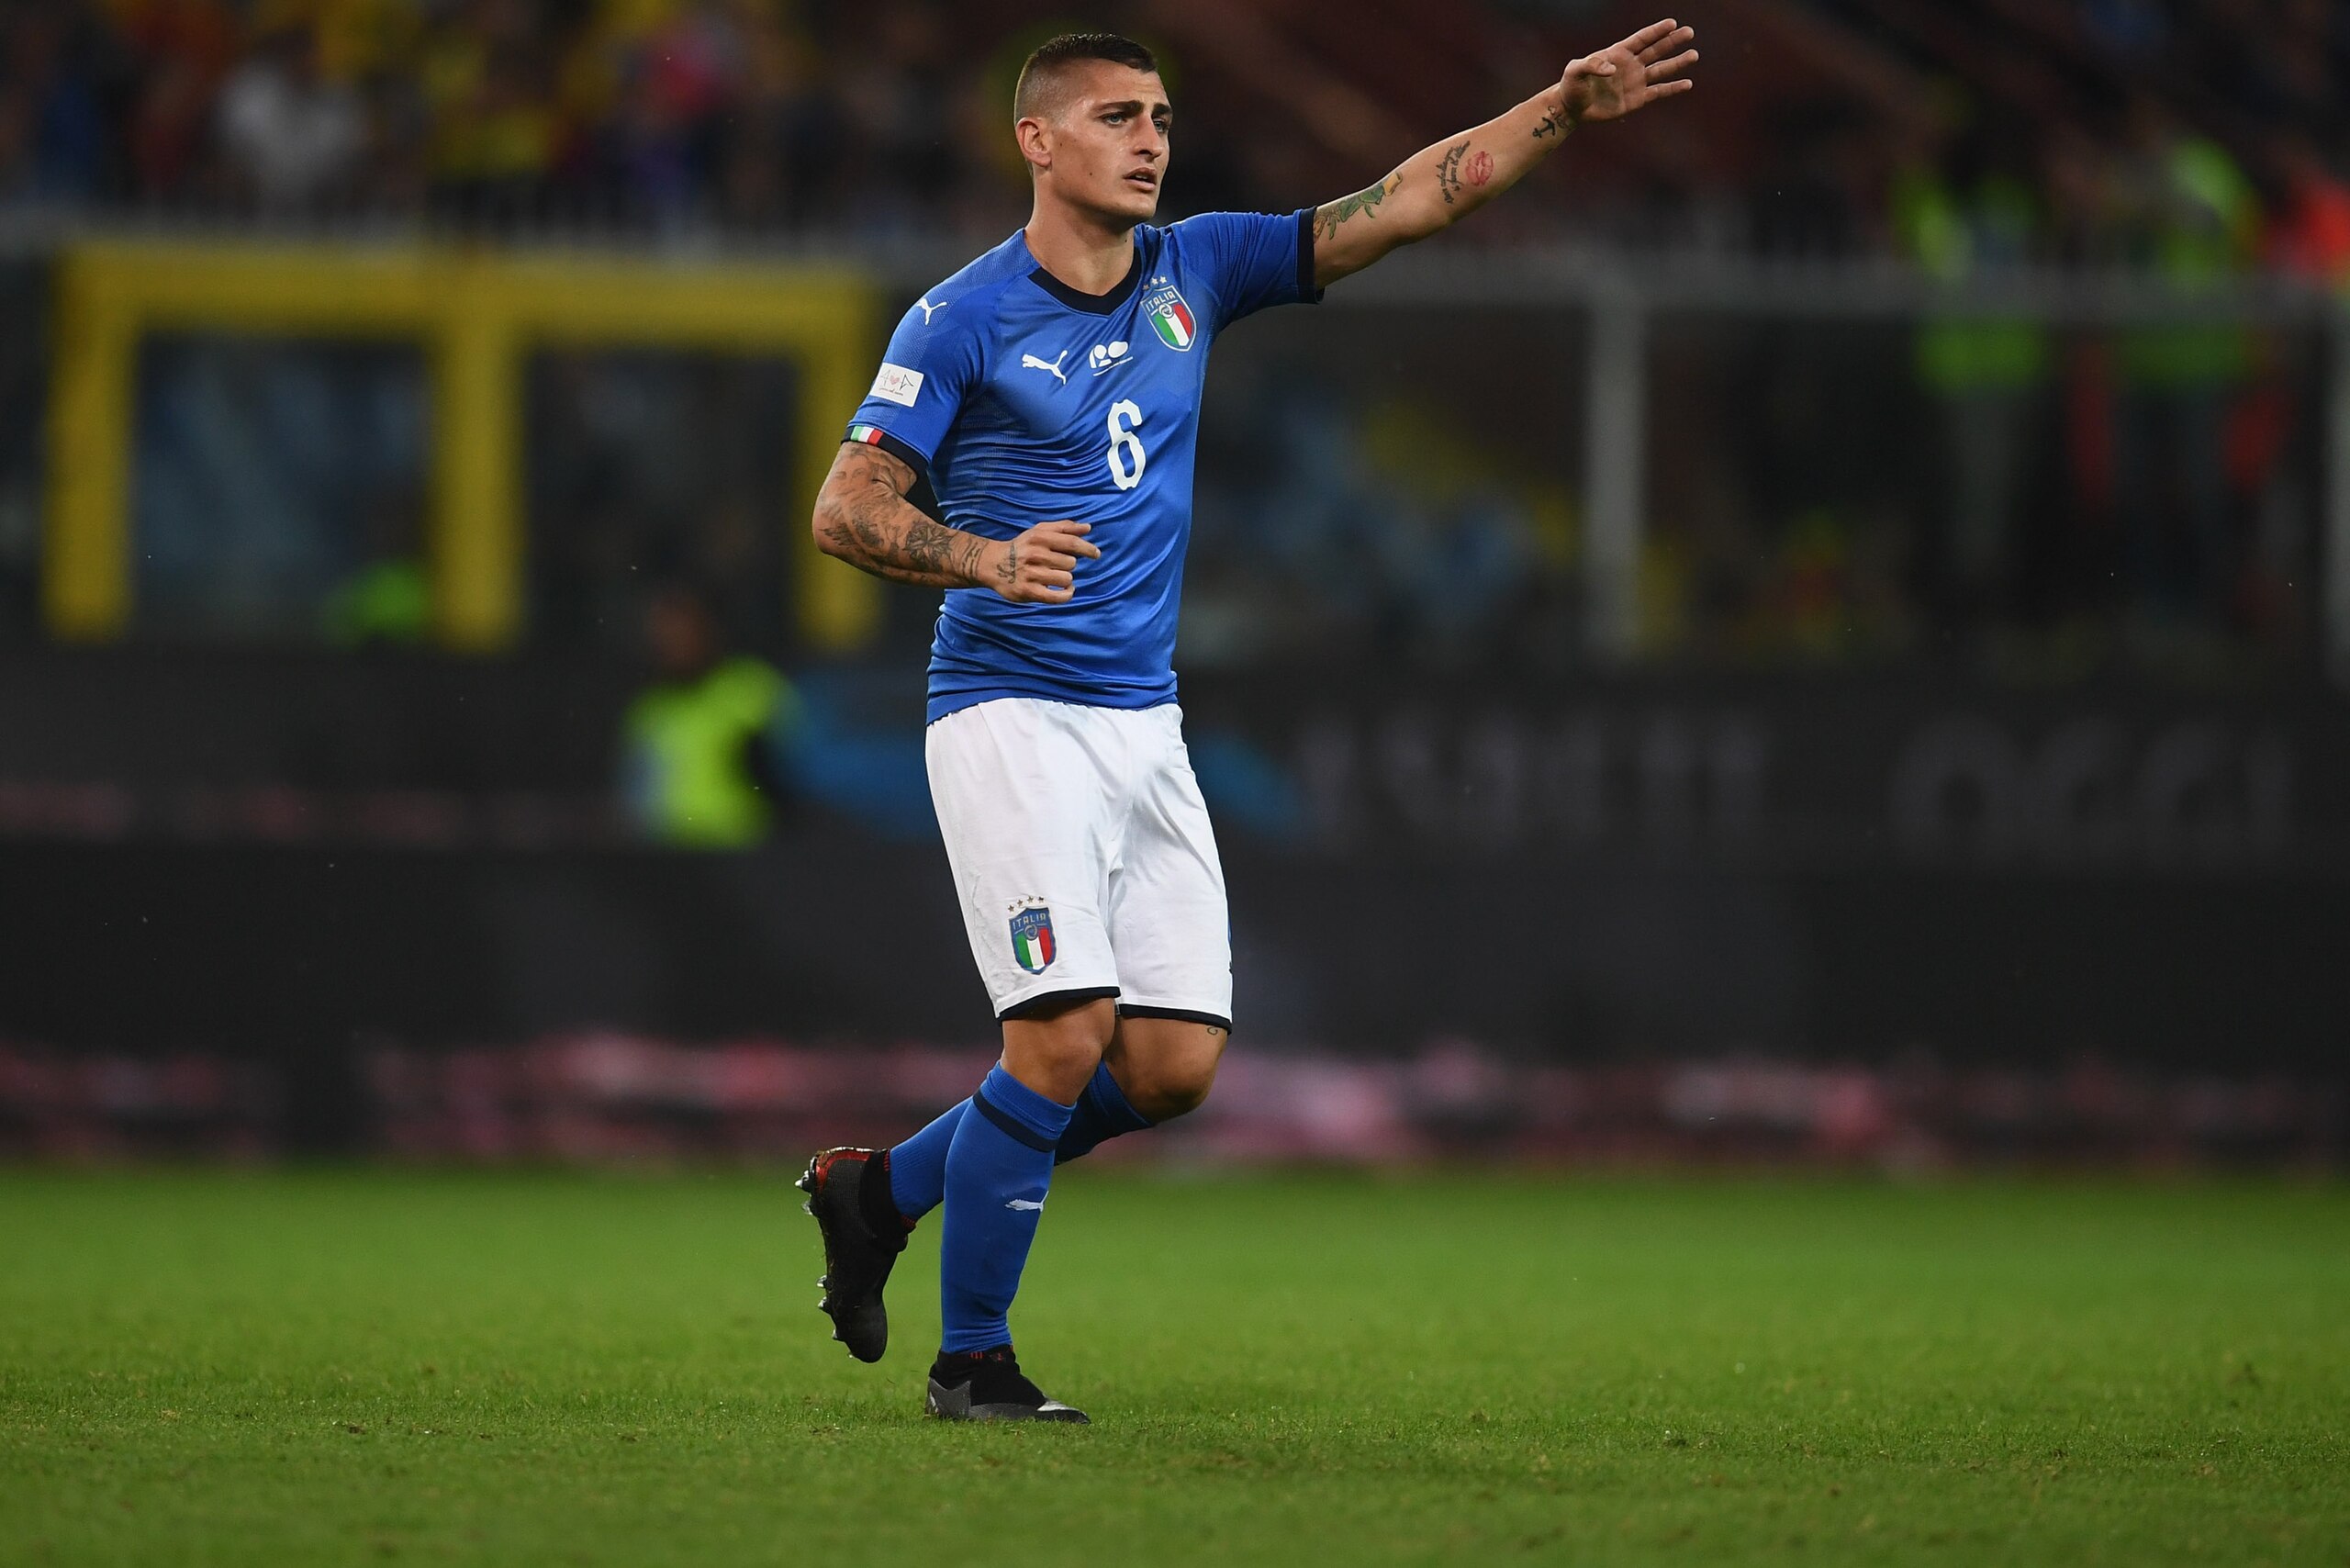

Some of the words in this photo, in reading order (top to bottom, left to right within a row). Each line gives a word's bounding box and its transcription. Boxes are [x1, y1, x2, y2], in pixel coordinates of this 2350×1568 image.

[1146, 291, 1176, 312] ITALIA
[1107, 398, 1147, 491] 6
[1013, 913, 1046, 930] ITALIA
